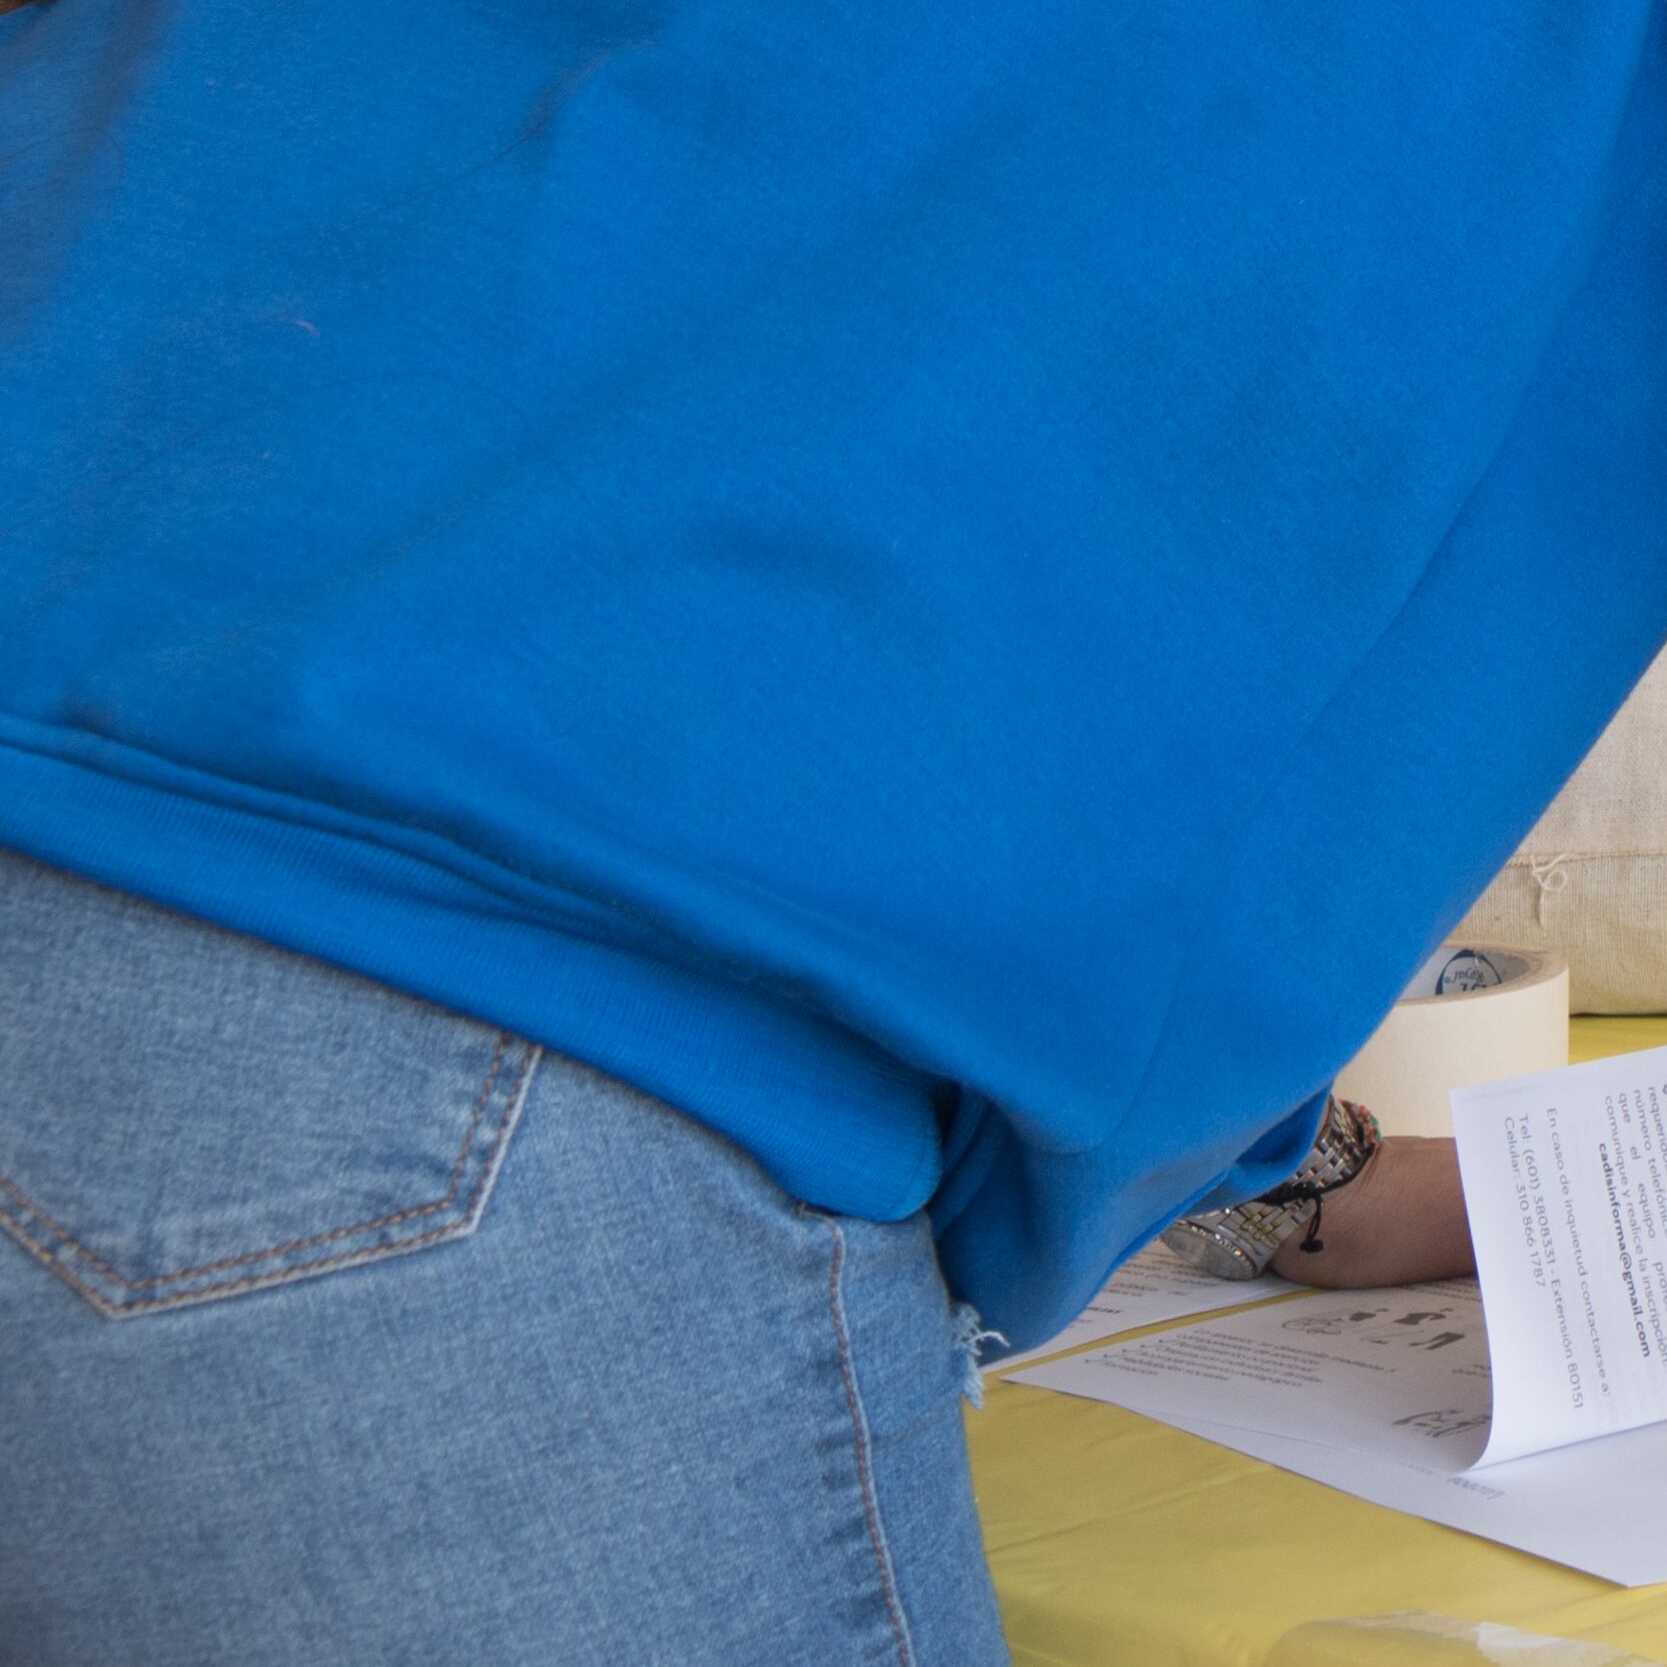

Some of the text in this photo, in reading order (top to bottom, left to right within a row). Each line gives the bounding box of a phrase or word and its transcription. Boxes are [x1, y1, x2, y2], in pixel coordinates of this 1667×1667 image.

[1518, 1113, 1531, 1143] Tel:
[1546, 1107, 1558, 1127] En
[1551, 1128, 1567, 1173] caso
[1633, 1089, 1653, 1152] número
[1503, 1116, 1546, 1288] Celular: 310 866 1787
[1522, 1149, 1542, 1191] (601)
[1559, 1175, 1571, 1196] de
[1604, 1095, 1629, 1187] comunique
[1626, 1202, 1644, 1255] realice
[1636, 1257, 1647, 1273] la
[1619, 1092, 1632, 1124] que
[1630, 1145, 1639, 1161] el
[1636, 1182, 1657, 1239] equipo
[1563, 1200, 1586, 1279] inquietud
[1598, 1142, 1651, 1358] cadisinforma@gmail.com
[1551, 1279, 1575, 1357] Extensión
[1580, 1281, 1607, 1379] contactarse
